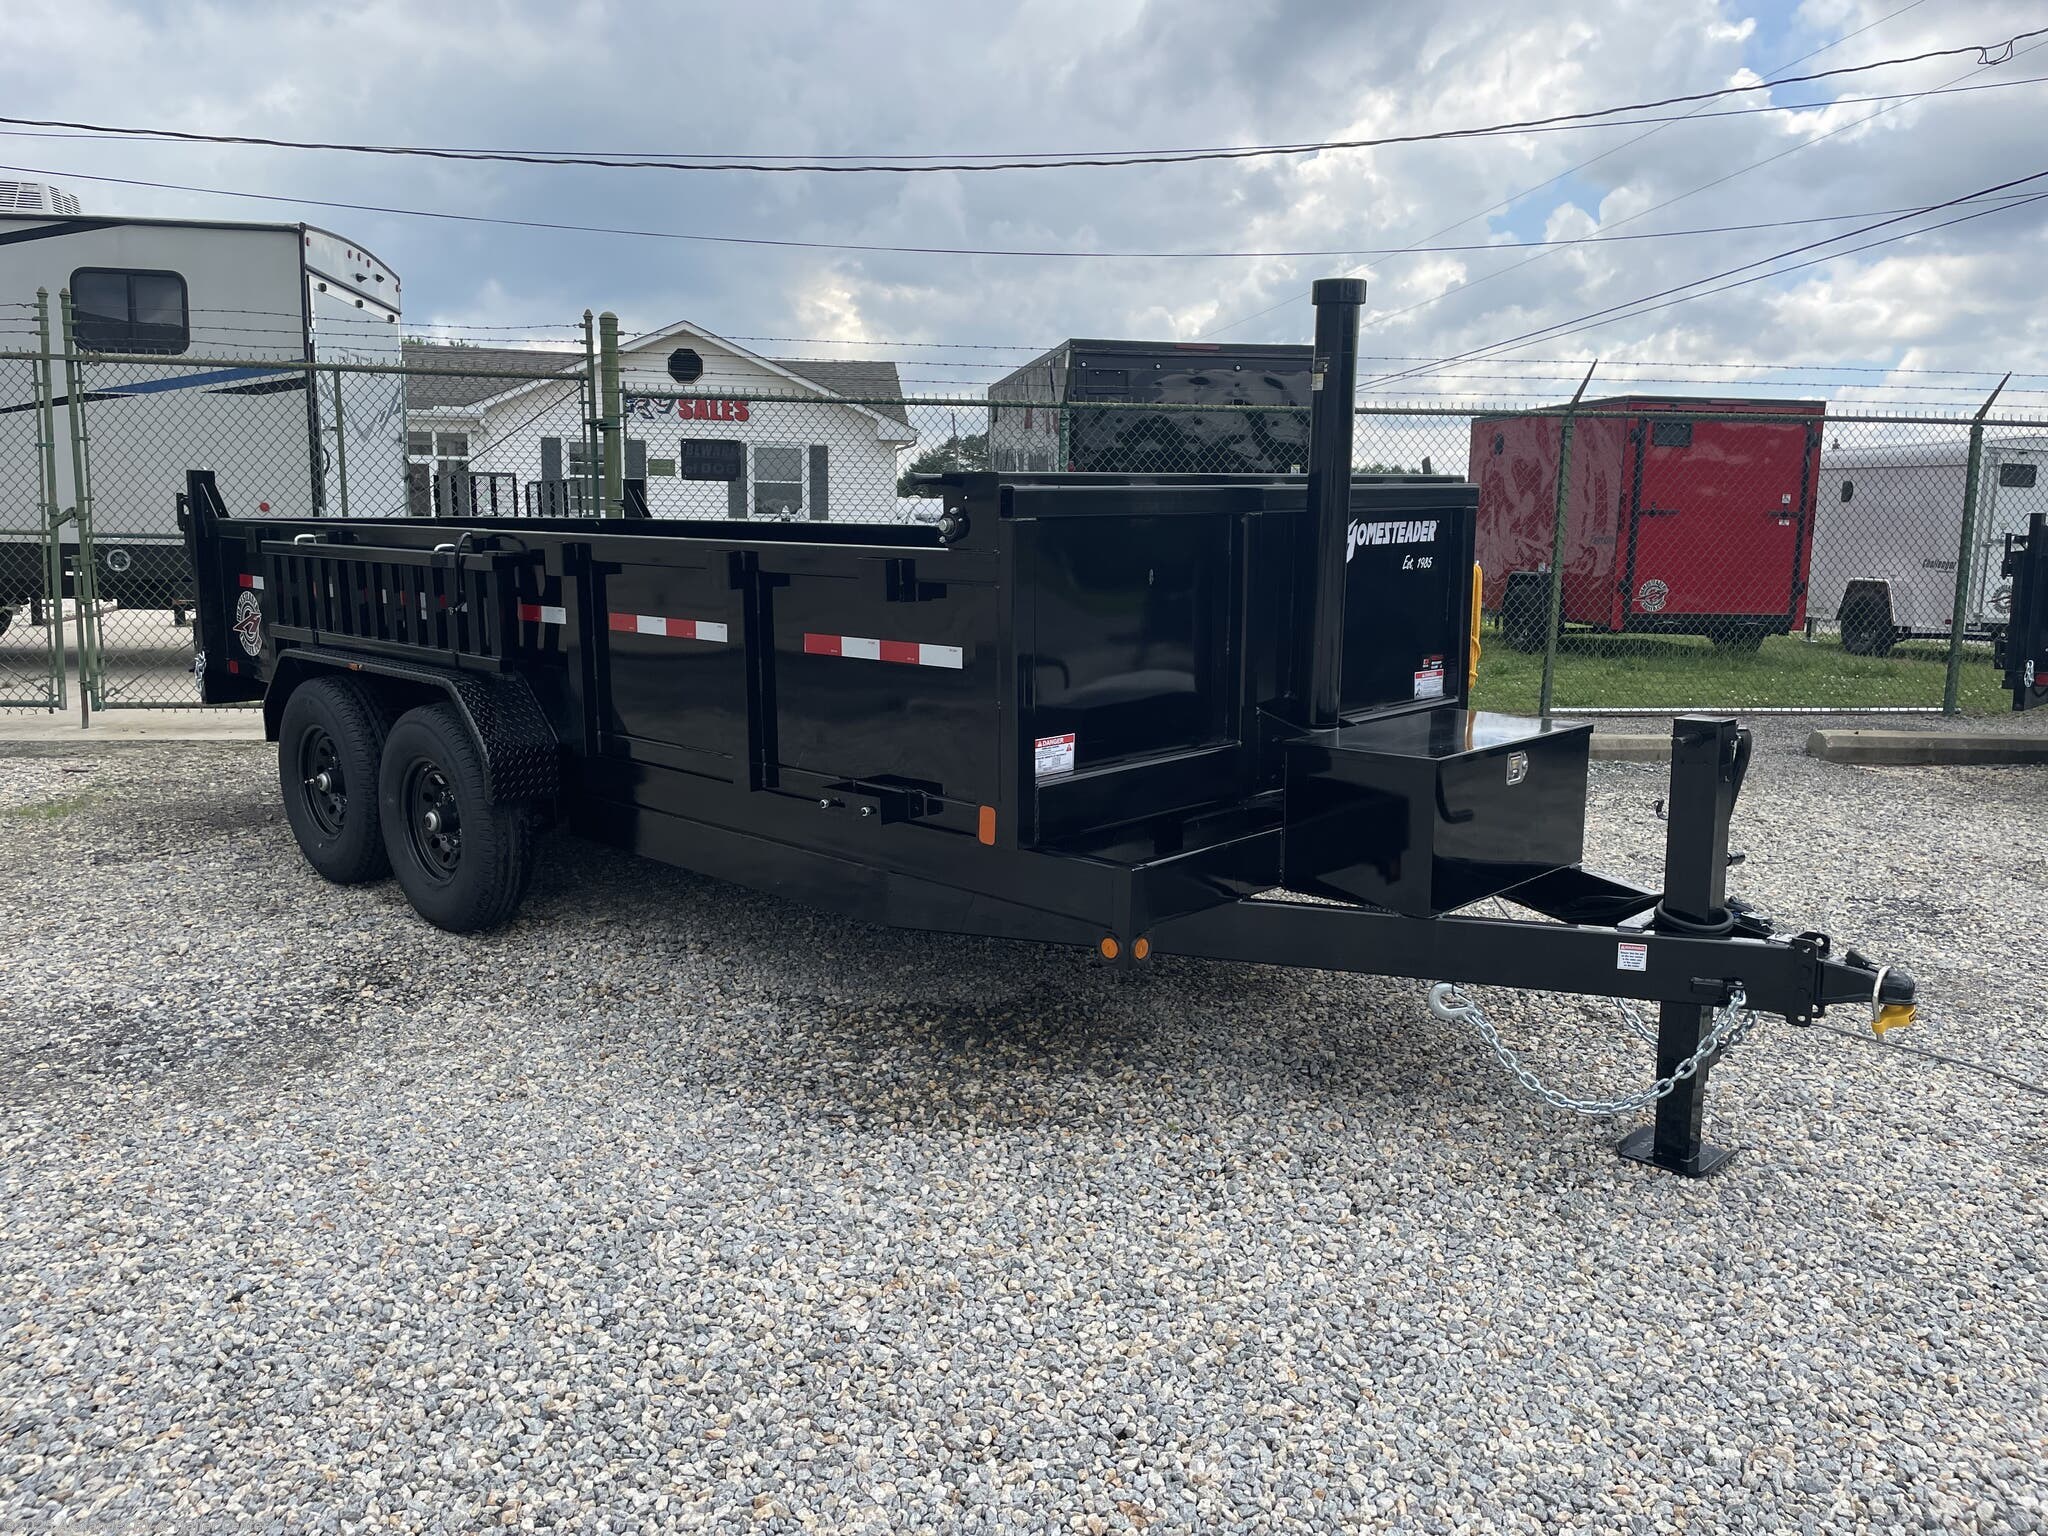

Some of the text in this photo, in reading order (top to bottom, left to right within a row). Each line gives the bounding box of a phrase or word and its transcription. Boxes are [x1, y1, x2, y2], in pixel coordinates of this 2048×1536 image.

[677, 398, 750, 421] SALES
[1416, 557, 1433, 569] 1985
[1042, 738, 1064, 746] DANGER
